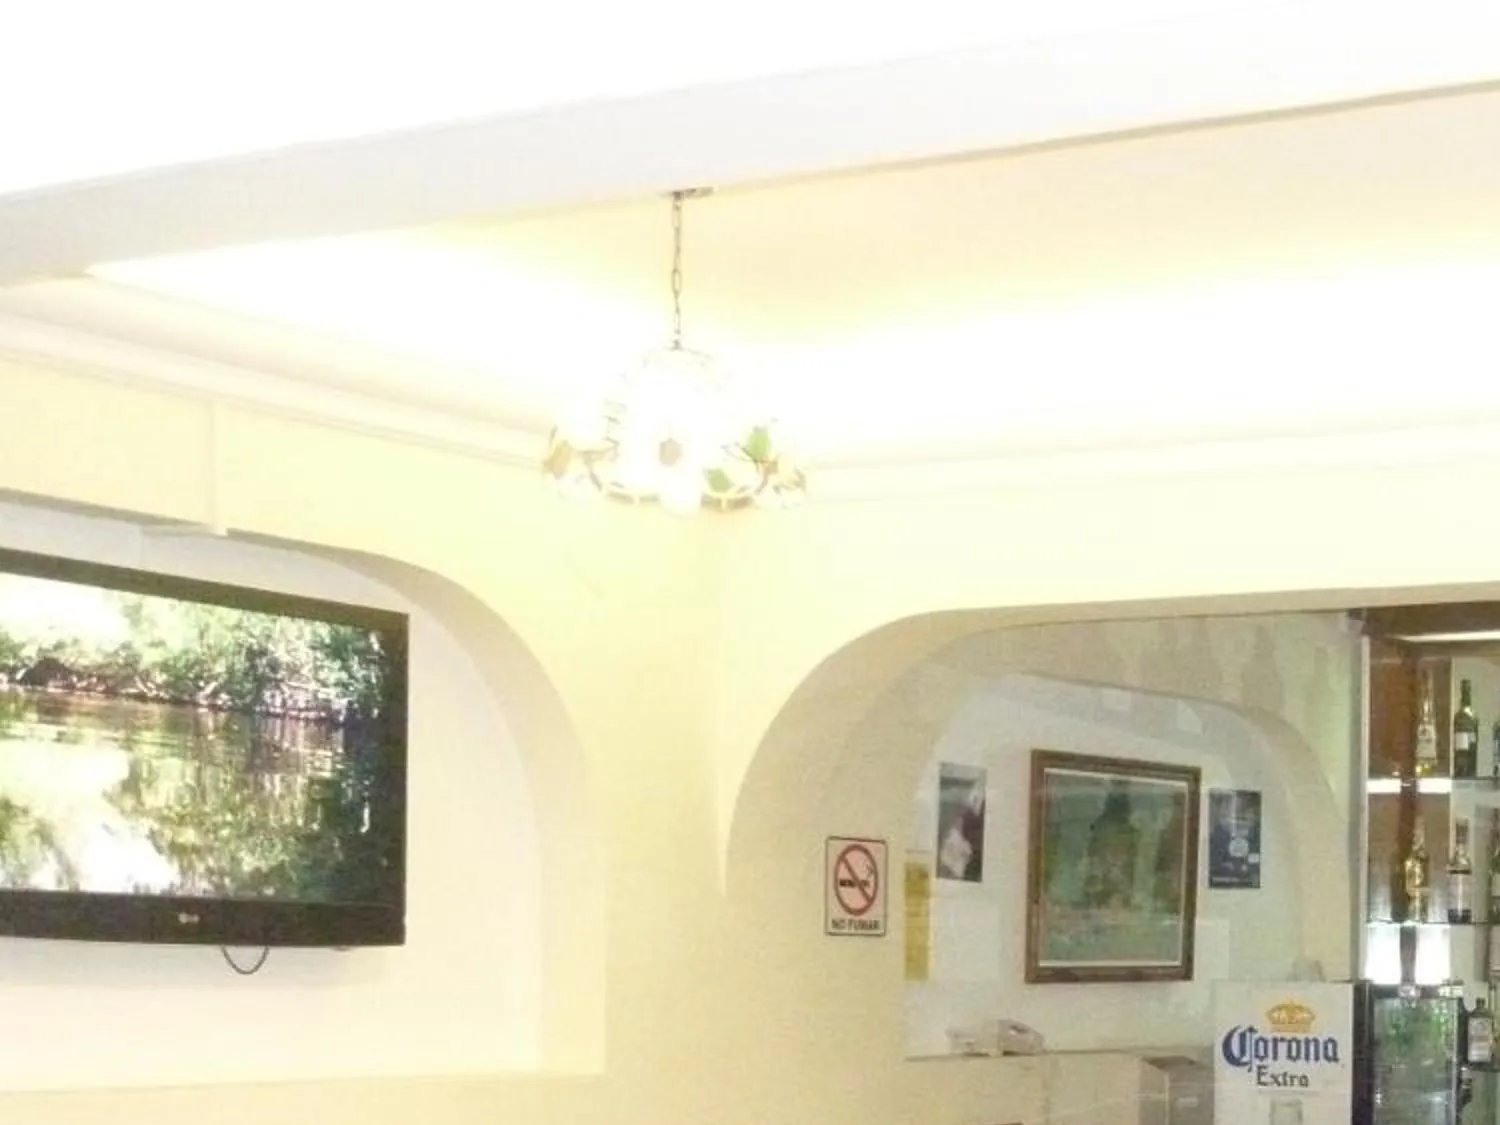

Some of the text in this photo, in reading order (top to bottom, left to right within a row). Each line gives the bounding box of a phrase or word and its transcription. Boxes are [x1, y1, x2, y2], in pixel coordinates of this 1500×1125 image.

[832, 918, 846, 930] NO
[1222, 1024, 1340, 1072] Corona
[1256, 1064, 1309, 1087] Extra
